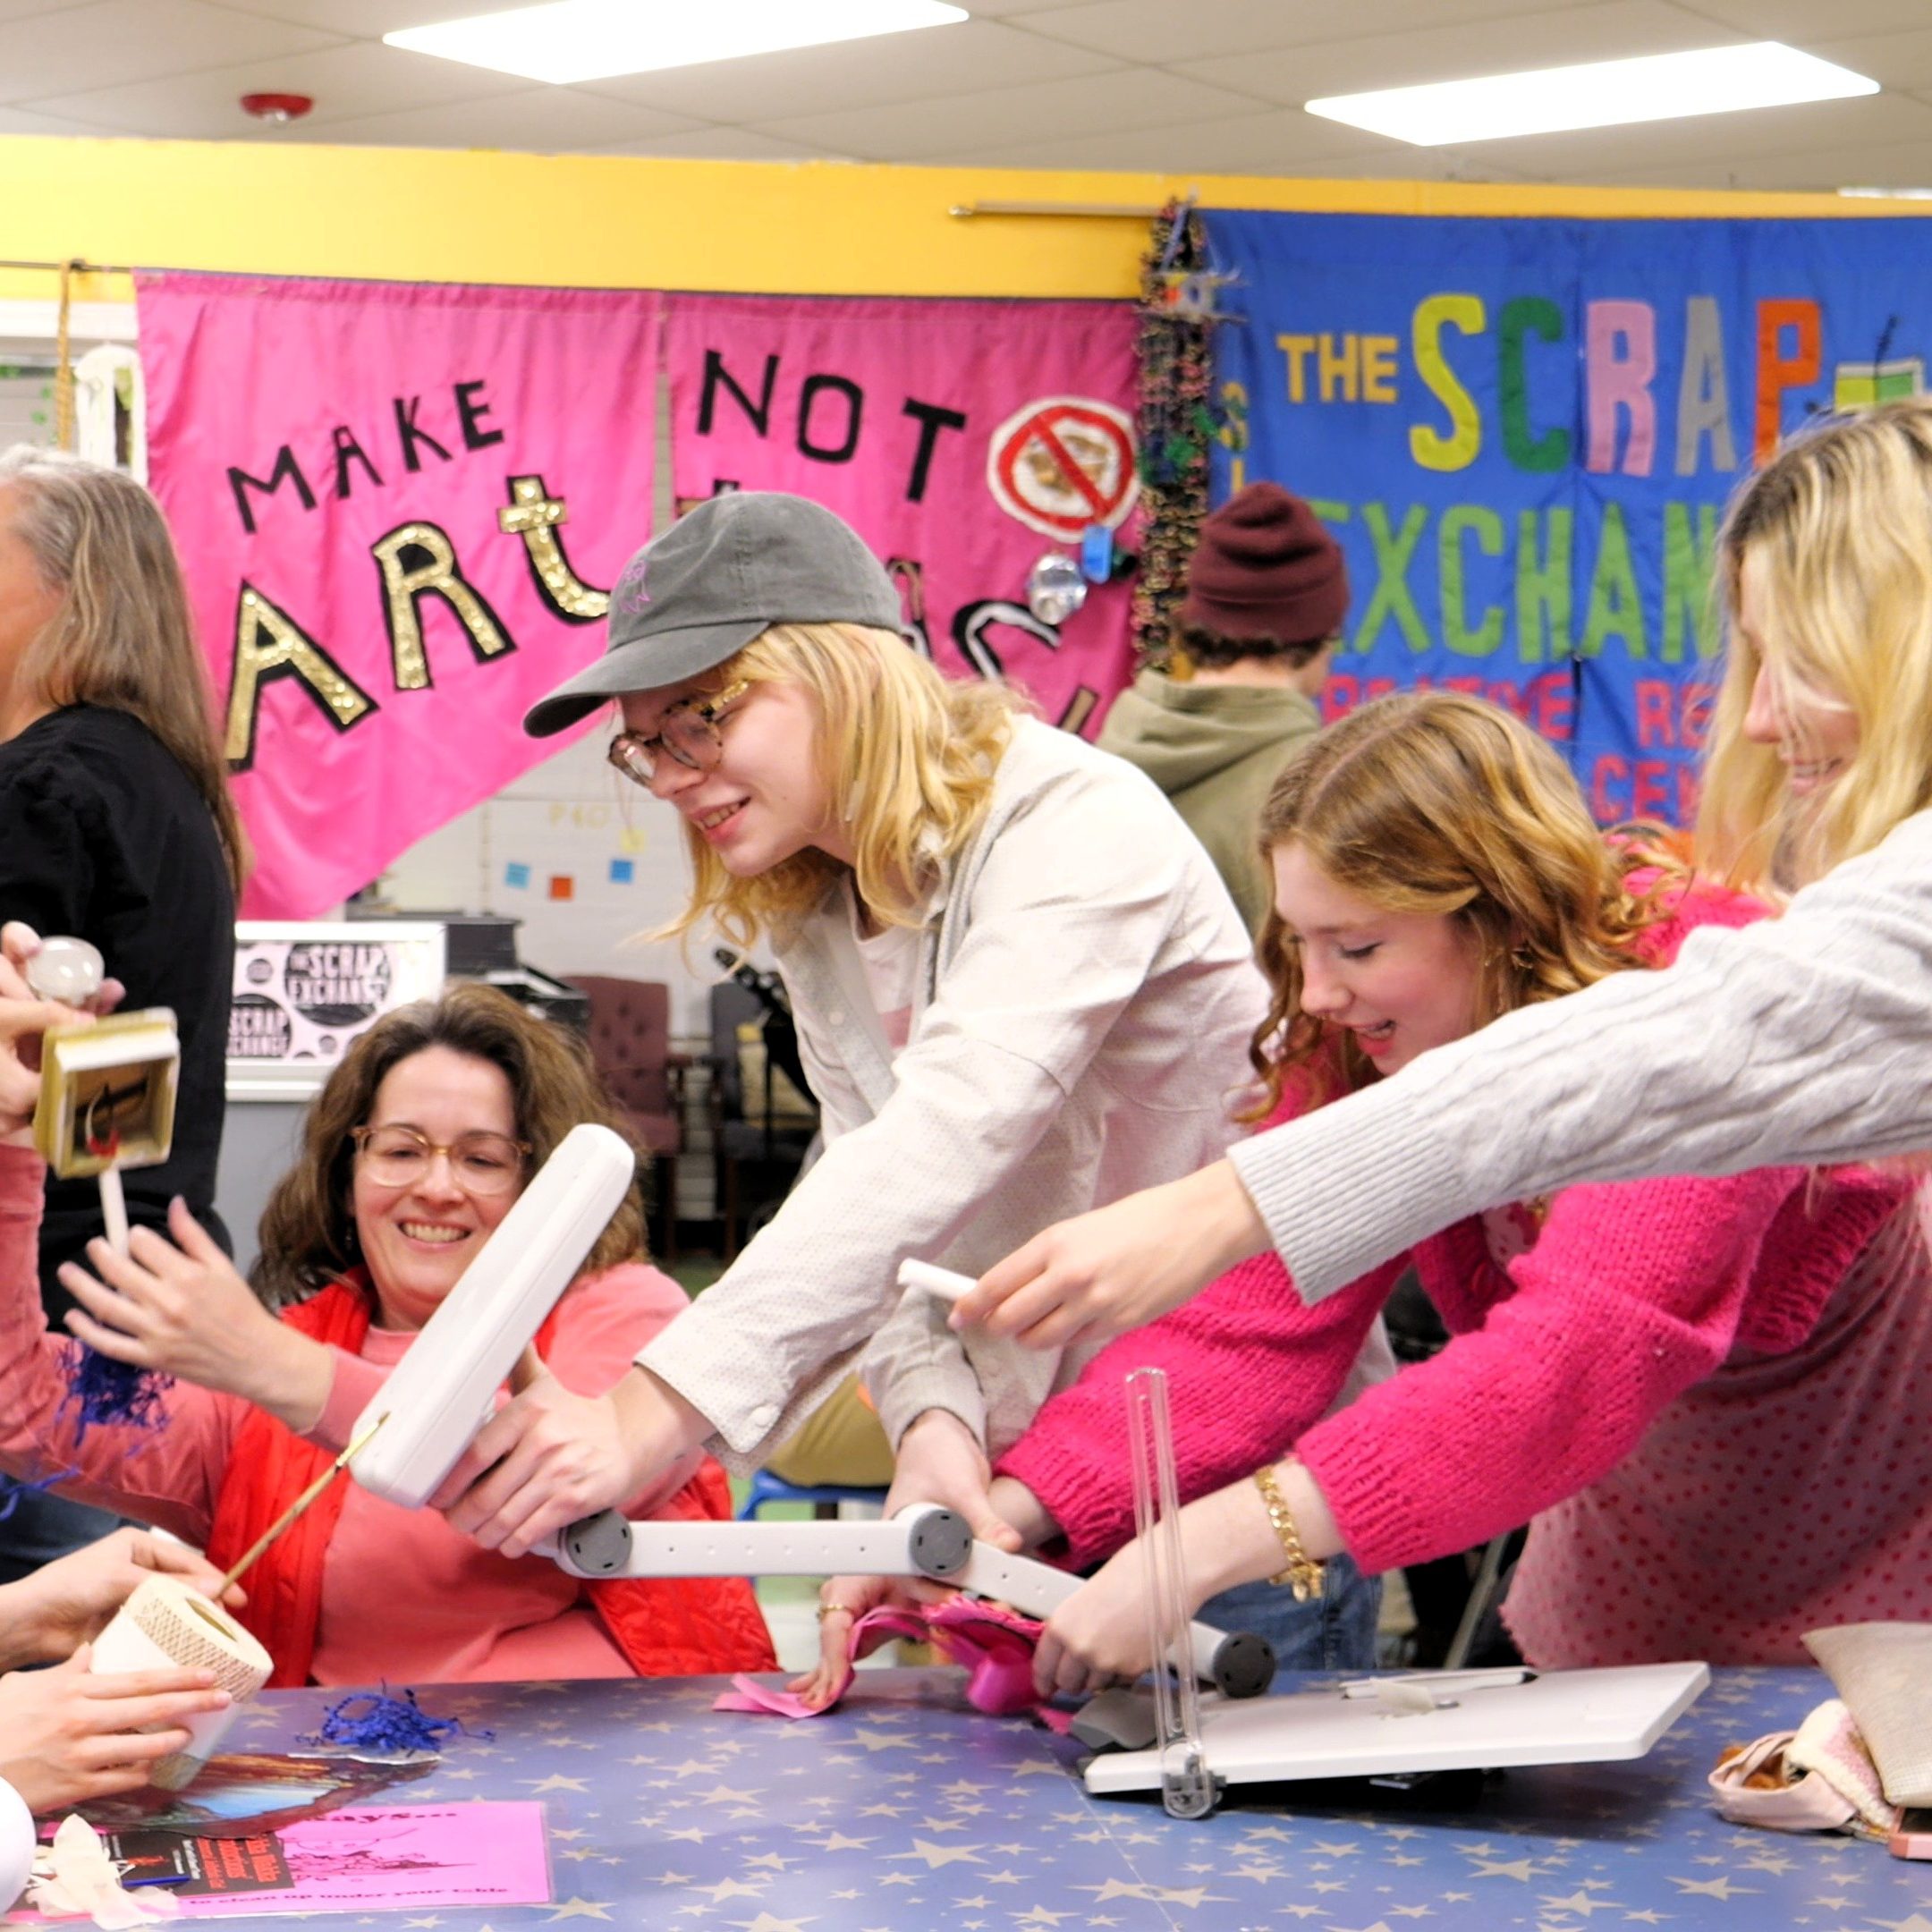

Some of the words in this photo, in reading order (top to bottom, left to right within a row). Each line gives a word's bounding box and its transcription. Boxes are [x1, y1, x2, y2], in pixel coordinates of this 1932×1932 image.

[226, 379, 504, 534] MAKE
[696, 349, 967, 504] NOT
[1276, 333, 1399, 403] THE
[1410, 292, 1822, 477] SCRAP
[1308, 500, 1719, 665] XCHAN
[309, 945, 384, 978] SCRAP
